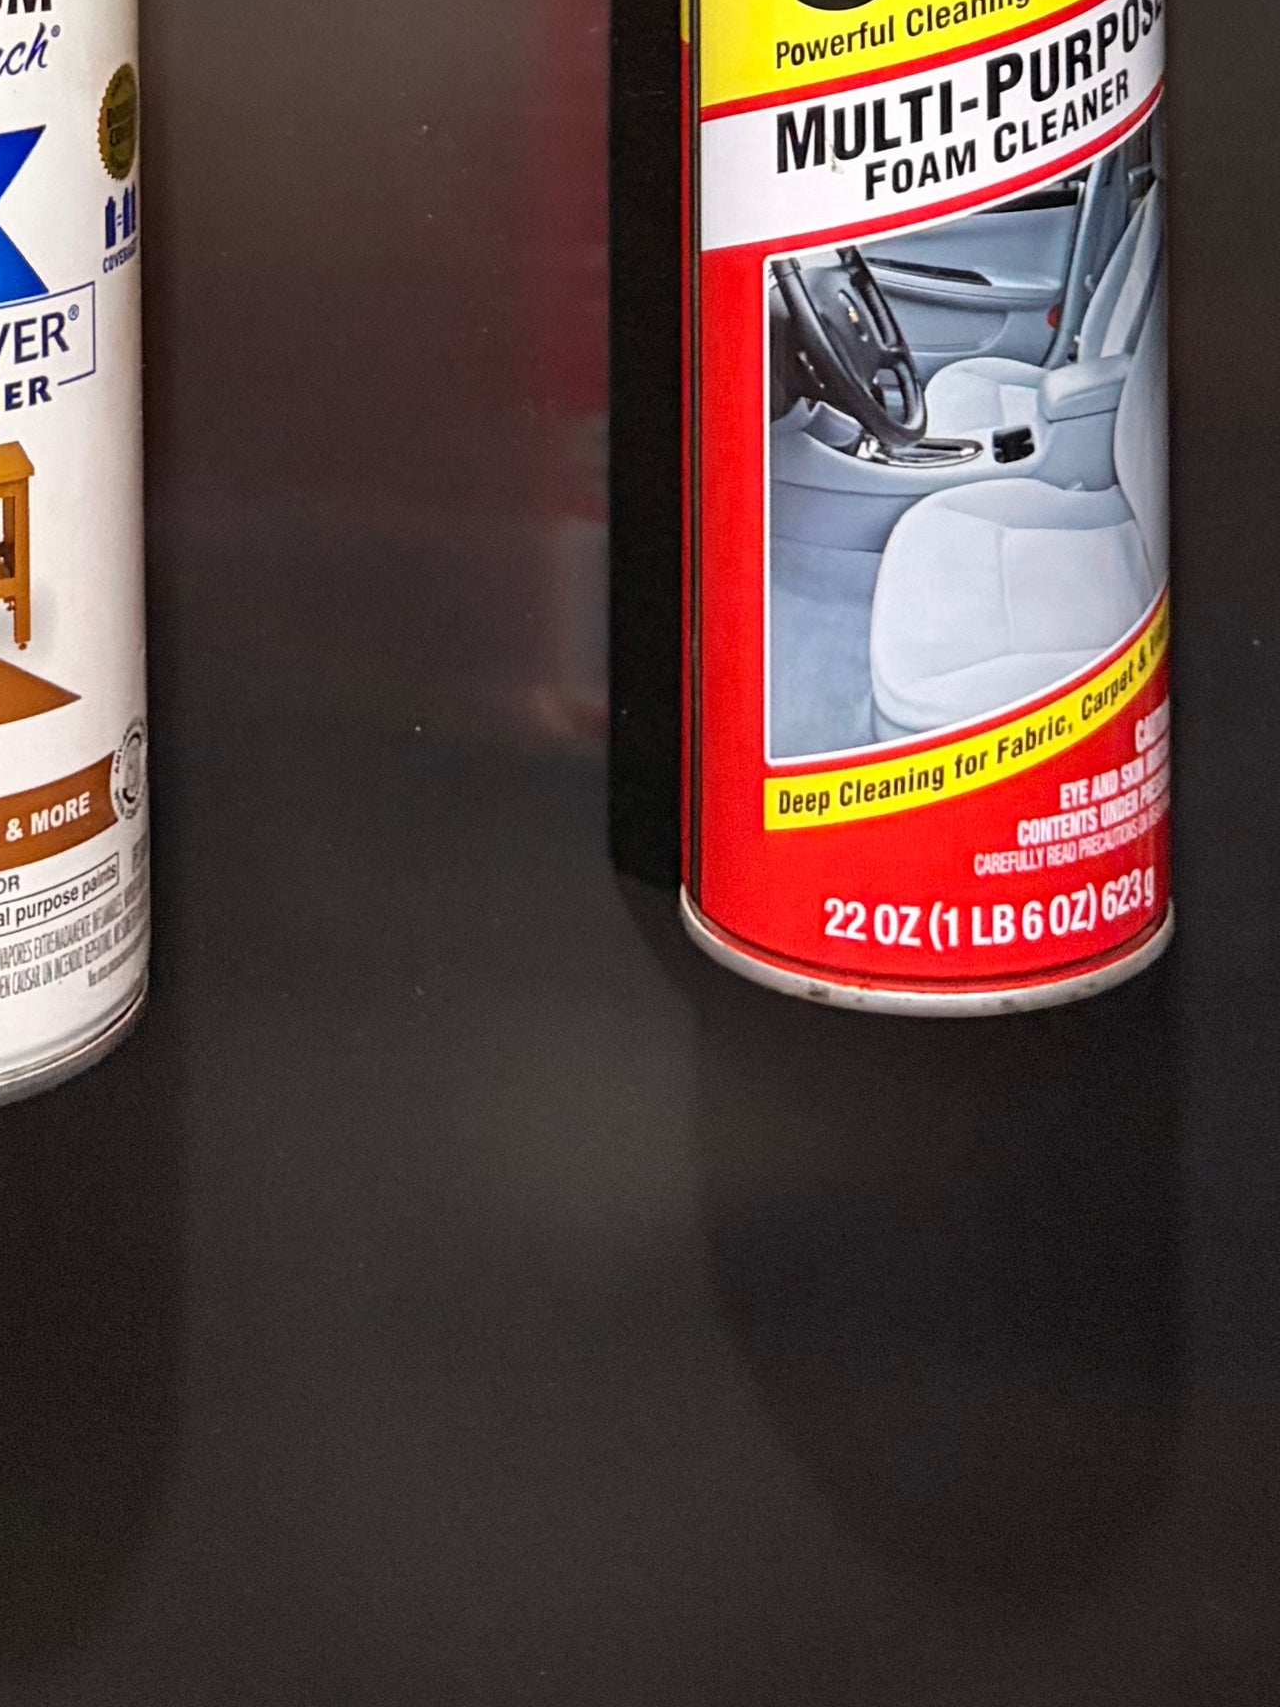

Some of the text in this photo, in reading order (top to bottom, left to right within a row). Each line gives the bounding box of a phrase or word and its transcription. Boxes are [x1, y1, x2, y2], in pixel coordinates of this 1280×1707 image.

[776, 14, 895, 70] Powerful
[864, 67, 1130, 202] FOAM CLEANER
[777, 788, 831, 817] Deep
[839, 764, 946, 808] Cleaning
[954, 749, 990, 780] for
[996, 714, 1073, 765] Fabric,
[1081, 659, 1134, 722] Carpet
[6, 817, 24, 843] &
[30, 790, 91, 836] MORE
[1059, 777, 1089, 811] EYE
[1016, 805, 1099, 847] CONTENTS
[973, 847, 1046, 876] CAREFULLY
[15, 885, 80, 922] purpose
[823, 897, 868, 943] 22
[872, 903, 922, 948] OZ
[928, 900, 960, 952] (1
[970, 903, 1016, 947] LB
[1021, 899, 1044, 941] 6
[1049, 881, 1098, 937] OZ)
